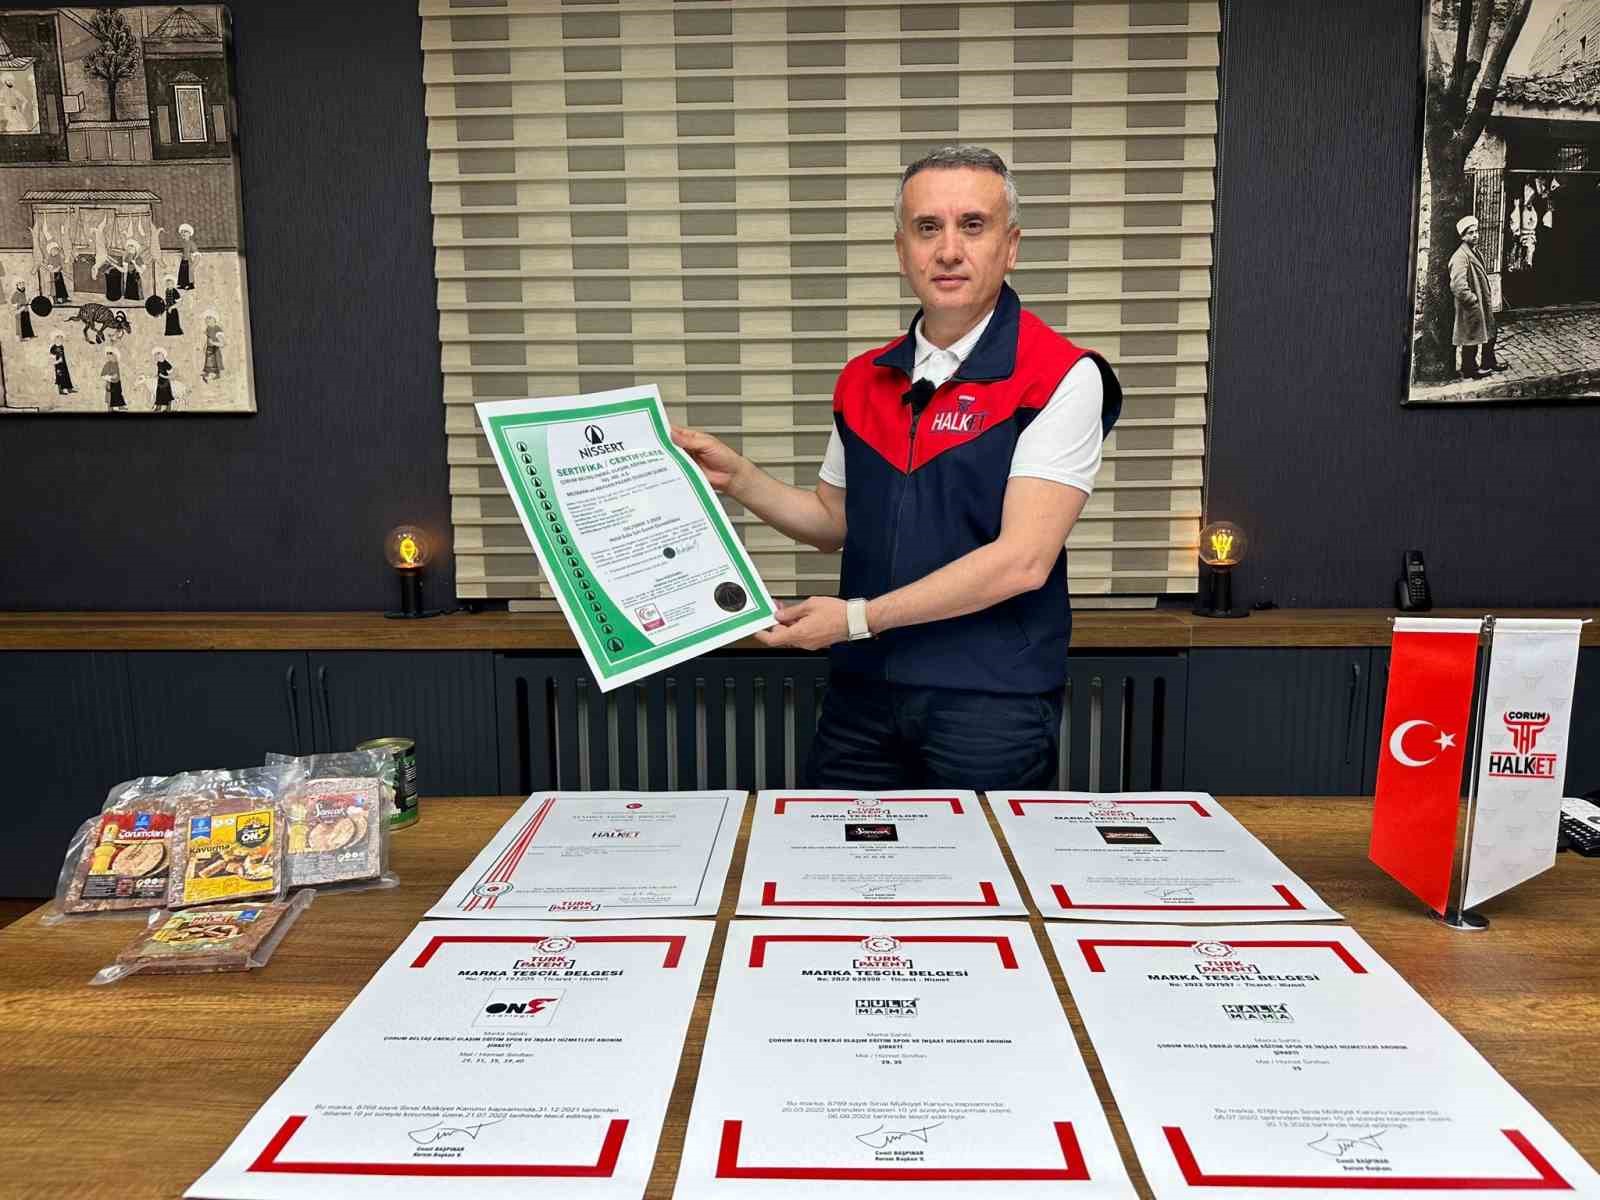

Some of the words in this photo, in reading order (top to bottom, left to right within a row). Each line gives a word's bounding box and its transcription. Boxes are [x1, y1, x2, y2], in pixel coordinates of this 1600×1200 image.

[578, 441, 625, 459] NISSERT
[1508, 711, 1546, 720] ÇORUM
[1489, 755, 1557, 775] HALKET
[856, 1000, 916, 1008] HULK
